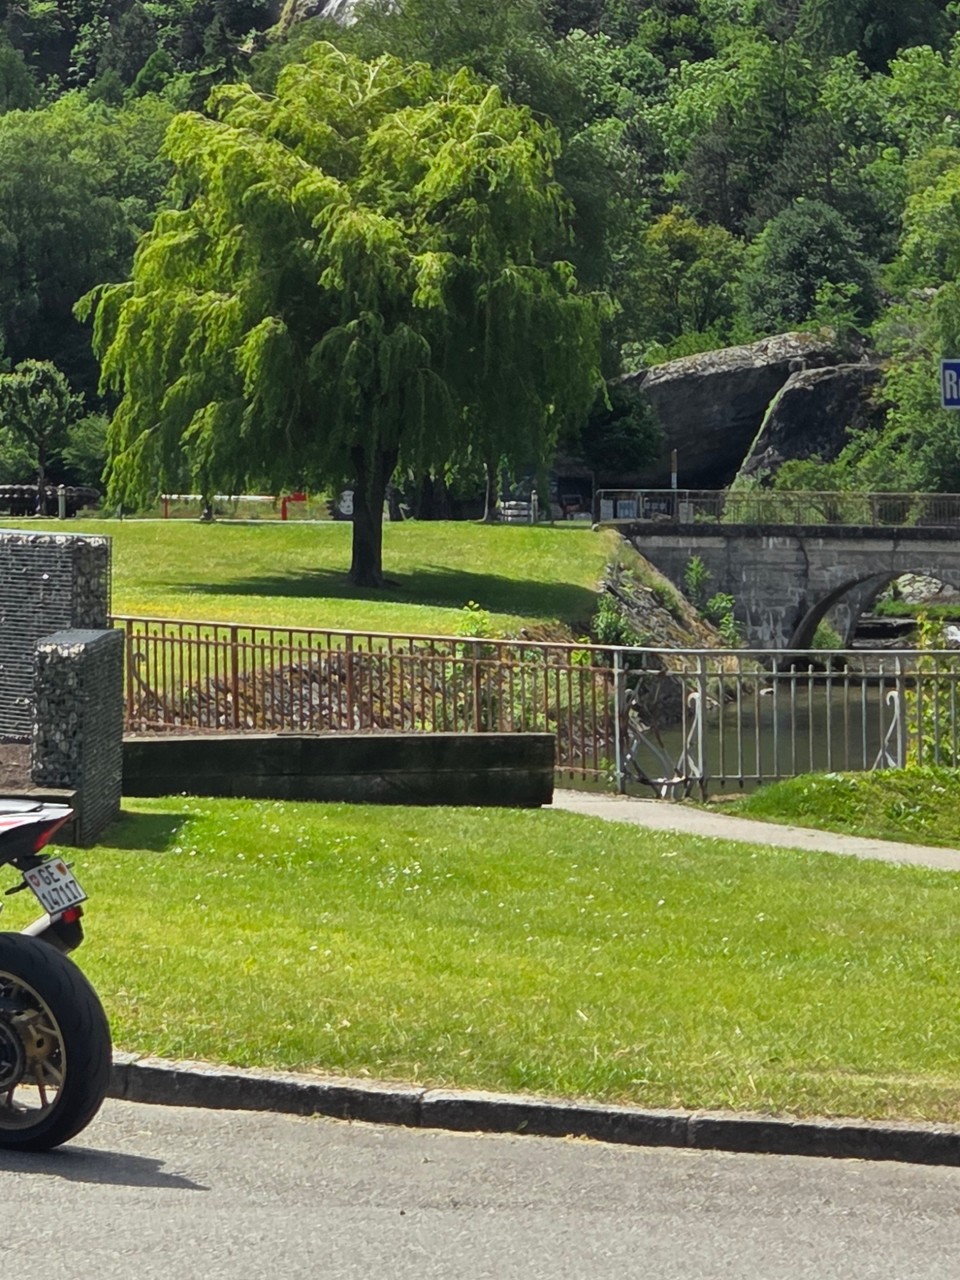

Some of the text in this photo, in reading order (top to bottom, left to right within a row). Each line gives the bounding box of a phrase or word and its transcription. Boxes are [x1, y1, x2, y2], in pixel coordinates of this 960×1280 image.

[944, 369, 960, 400] R
[38, 864, 61, 886] GE
[41, 880, 82, 910] 147117
